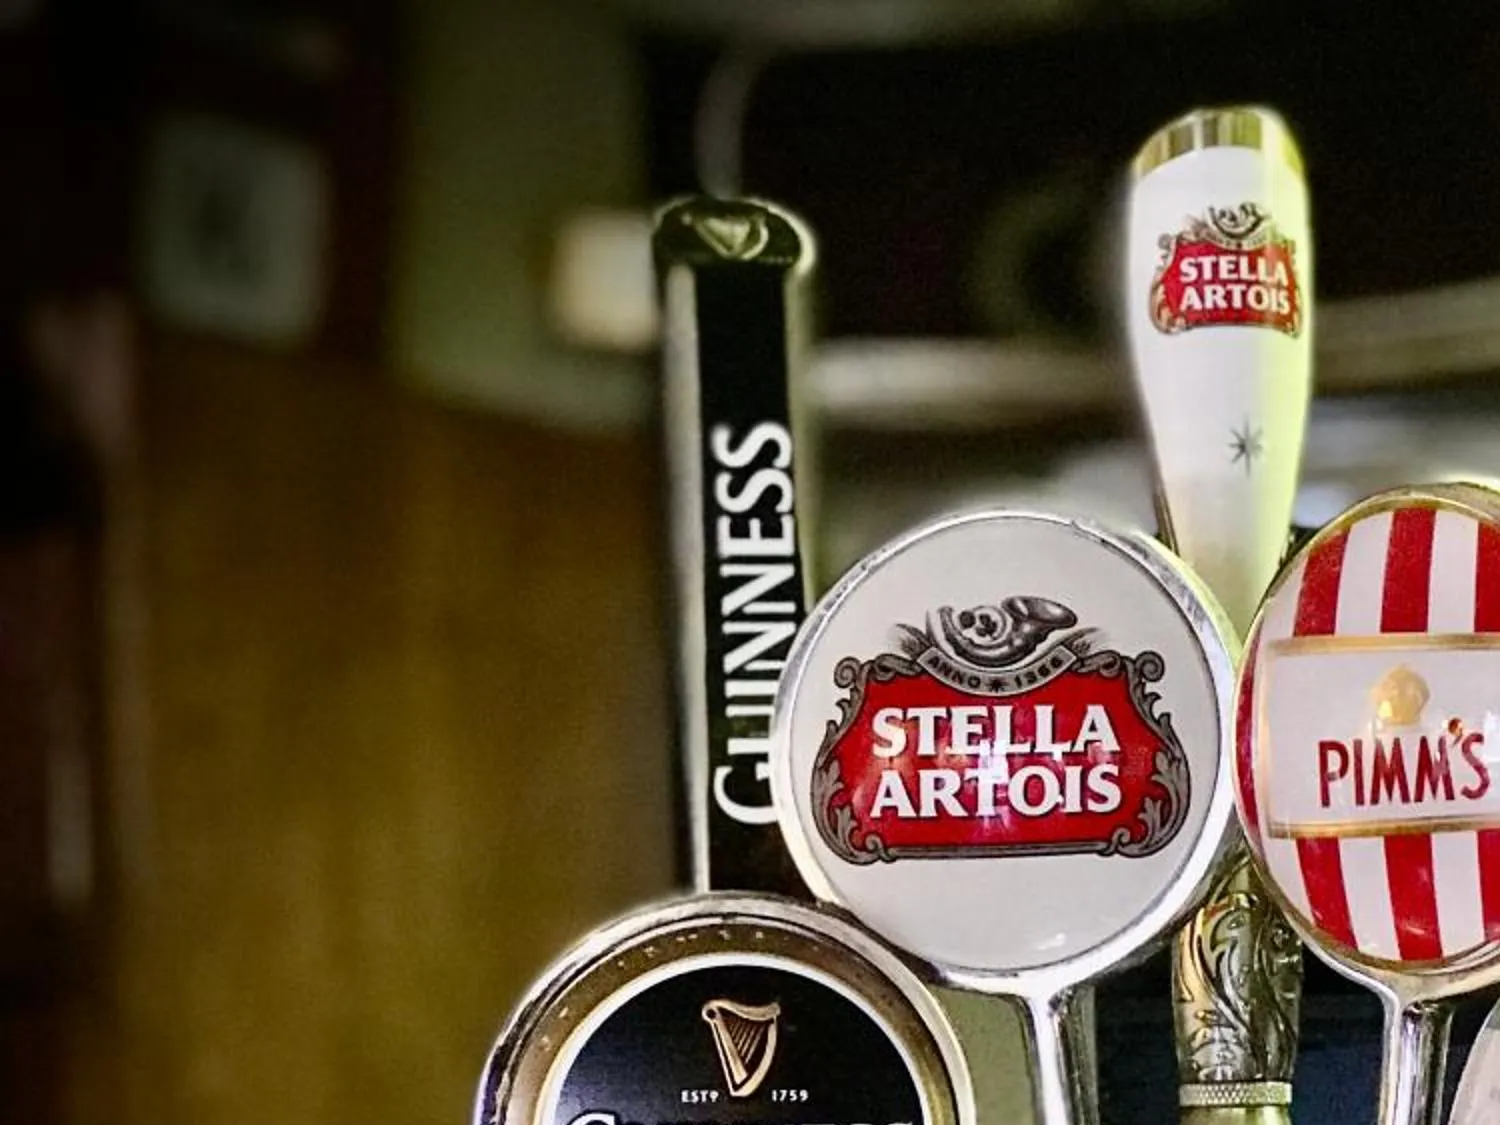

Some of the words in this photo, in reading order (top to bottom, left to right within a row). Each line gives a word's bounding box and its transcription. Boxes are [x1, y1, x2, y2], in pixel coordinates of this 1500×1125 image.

[1179, 255, 1289, 286] STELLA
[1179, 284, 1290, 314] ARTOIS
[927, 656, 981, 689] ANNO
[870, 703, 1121, 759] STELLA
[1317, 718, 1490, 808] PIMM'S
[869, 764, 1122, 818] ARTOIS
[772, 1089, 809, 1102] 1759
